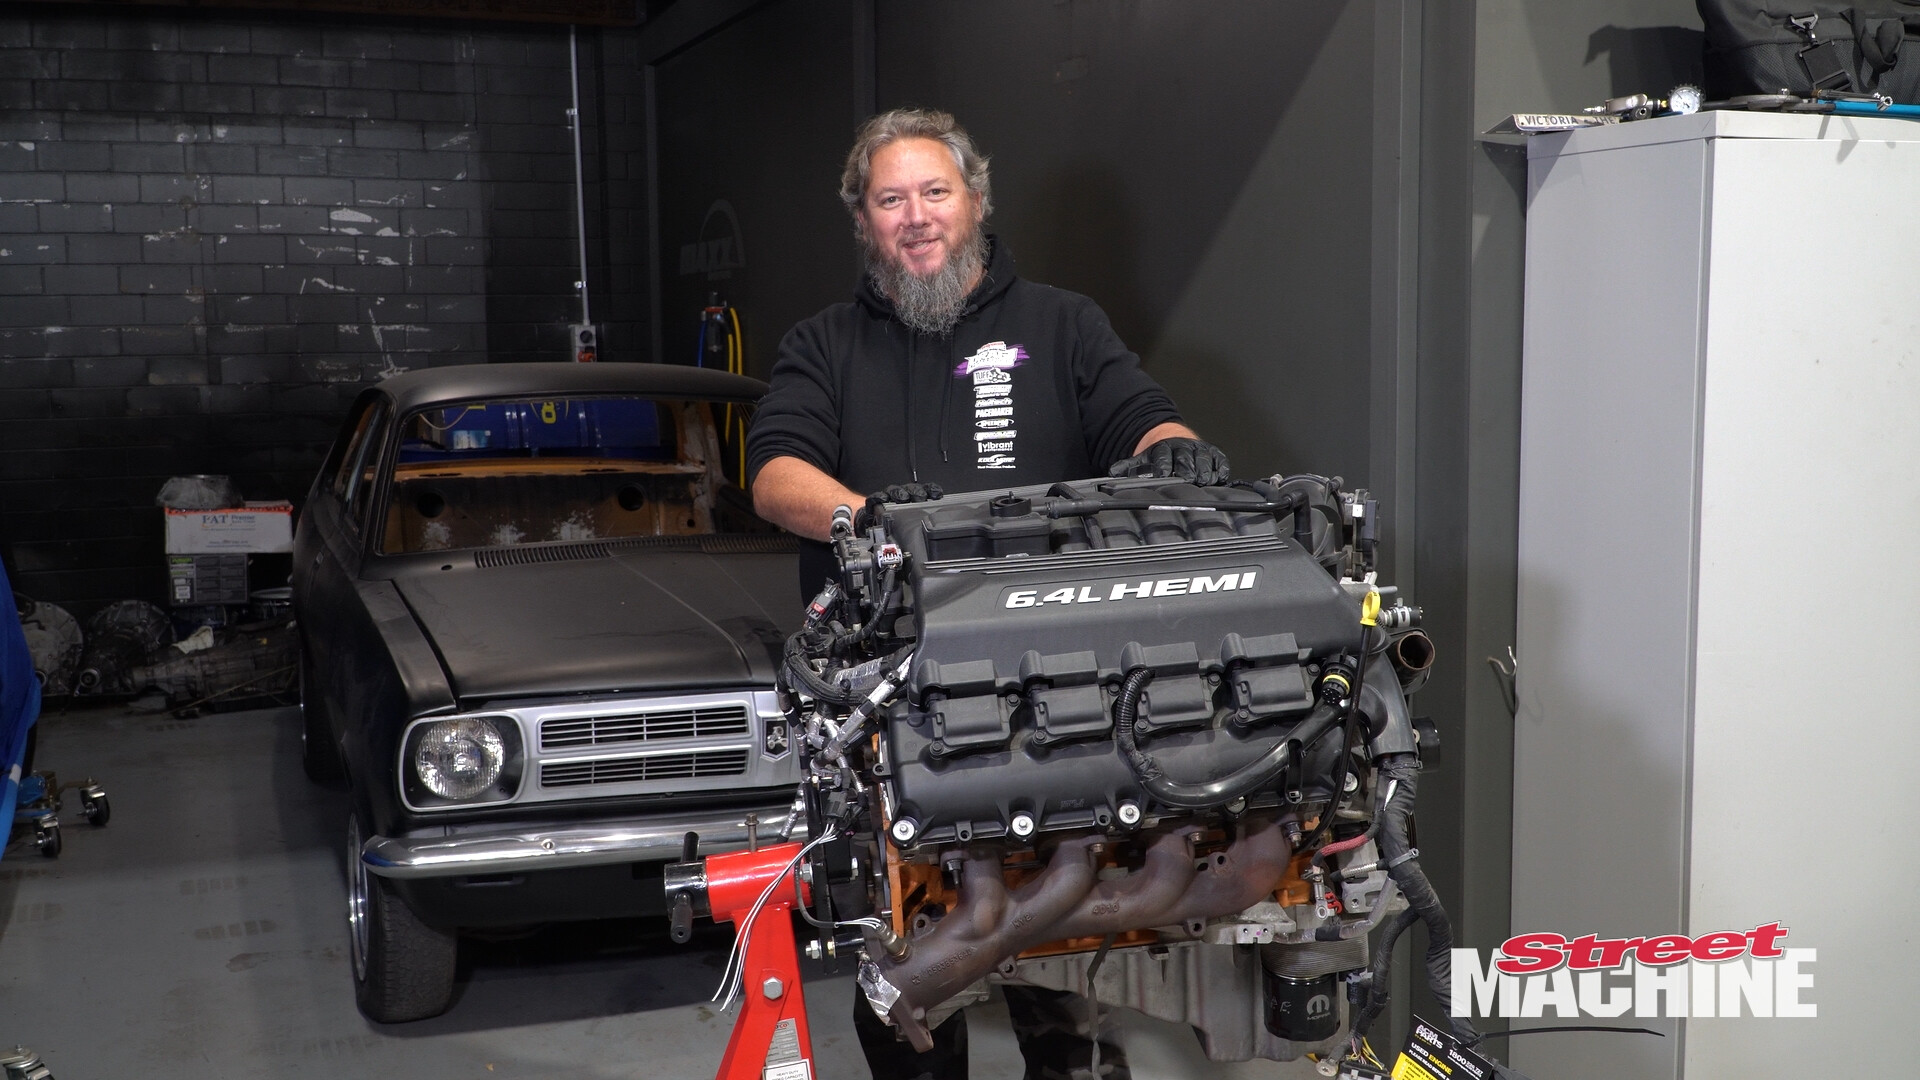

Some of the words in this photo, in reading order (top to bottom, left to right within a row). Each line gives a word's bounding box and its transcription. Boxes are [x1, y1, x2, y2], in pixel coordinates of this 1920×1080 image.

[1524, 115, 1579, 126] VICTORIA
[982, 441, 1013, 449] vibrant
[1005, 587, 1101, 609] 6.4L
[1109, 572, 1256, 600] HEMI
[1415, 1029, 1444, 1049] PARTS
[1416, 1024, 1439, 1040] ACM
[1411, 1042, 1429, 1057] USED
[1428, 1053, 1453, 1075] ENGINE
[1449, 1049, 1467, 1065] 1800
[1432, 1064, 1447, 1079] BEFORE
